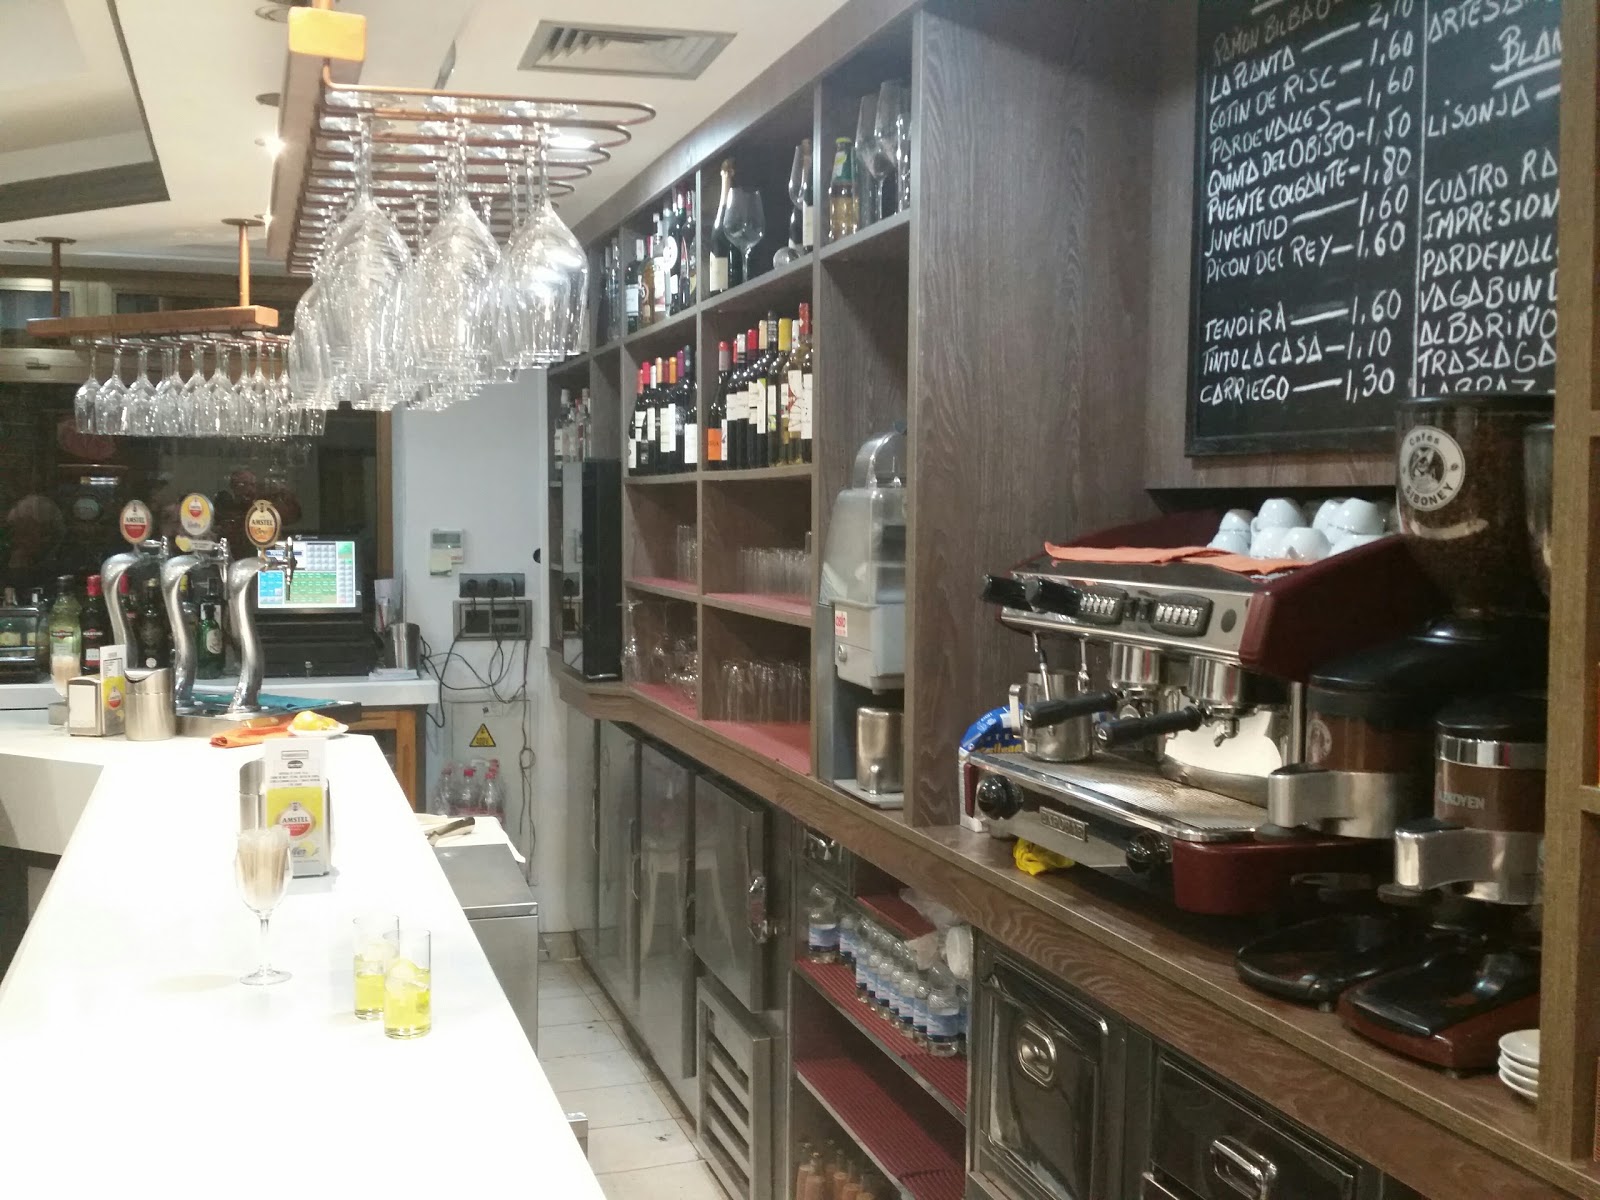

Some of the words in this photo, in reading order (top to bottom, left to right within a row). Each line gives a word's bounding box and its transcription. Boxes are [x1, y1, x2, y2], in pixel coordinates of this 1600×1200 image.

[1256, 86, 1277, 116] DE
[1367, 30, 1414, 67] 1,60
[1210, 100, 1331, 164] PARDEVALLES
[1366, 65, 1415, 110] 1,60
[1427, 84, 1531, 137] LISONJA
[1208, 157, 1260, 198] QUINTA
[1262, 149, 1287, 177] DEL
[1288, 120, 1354, 168] OBISPO
[1366, 105, 1411, 146] 1,50
[1206, 186, 1266, 225] PUENTE
[1269, 158, 1349, 210] COLGANTE
[1362, 146, 1412, 186] 1,80
[1424, 162, 1508, 205] CUATRO
[1204, 215, 1288, 257] JUVENTUD
[1358, 184, 1409, 227] 1,60
[1423, 188, 1560, 241] IMPRESION
[1206, 255, 1251, 284] PICON
[1254, 246, 1284, 275] DEL
[1290, 234, 1334, 267] REY
[1357, 220, 1406, 258] 1,60
[1421, 233, 1560, 281] PARDEVALL
[1205, 300, 1286, 342] TENOIRA
[1352, 288, 1401, 325] 1,60
[1347, 327, 1392, 360] 1,10
[1200, 374, 1289, 406] CARRIEGO
[1346, 363, 1396, 404] 1,30
[1405, 482, 1453, 506] SIBONEY
